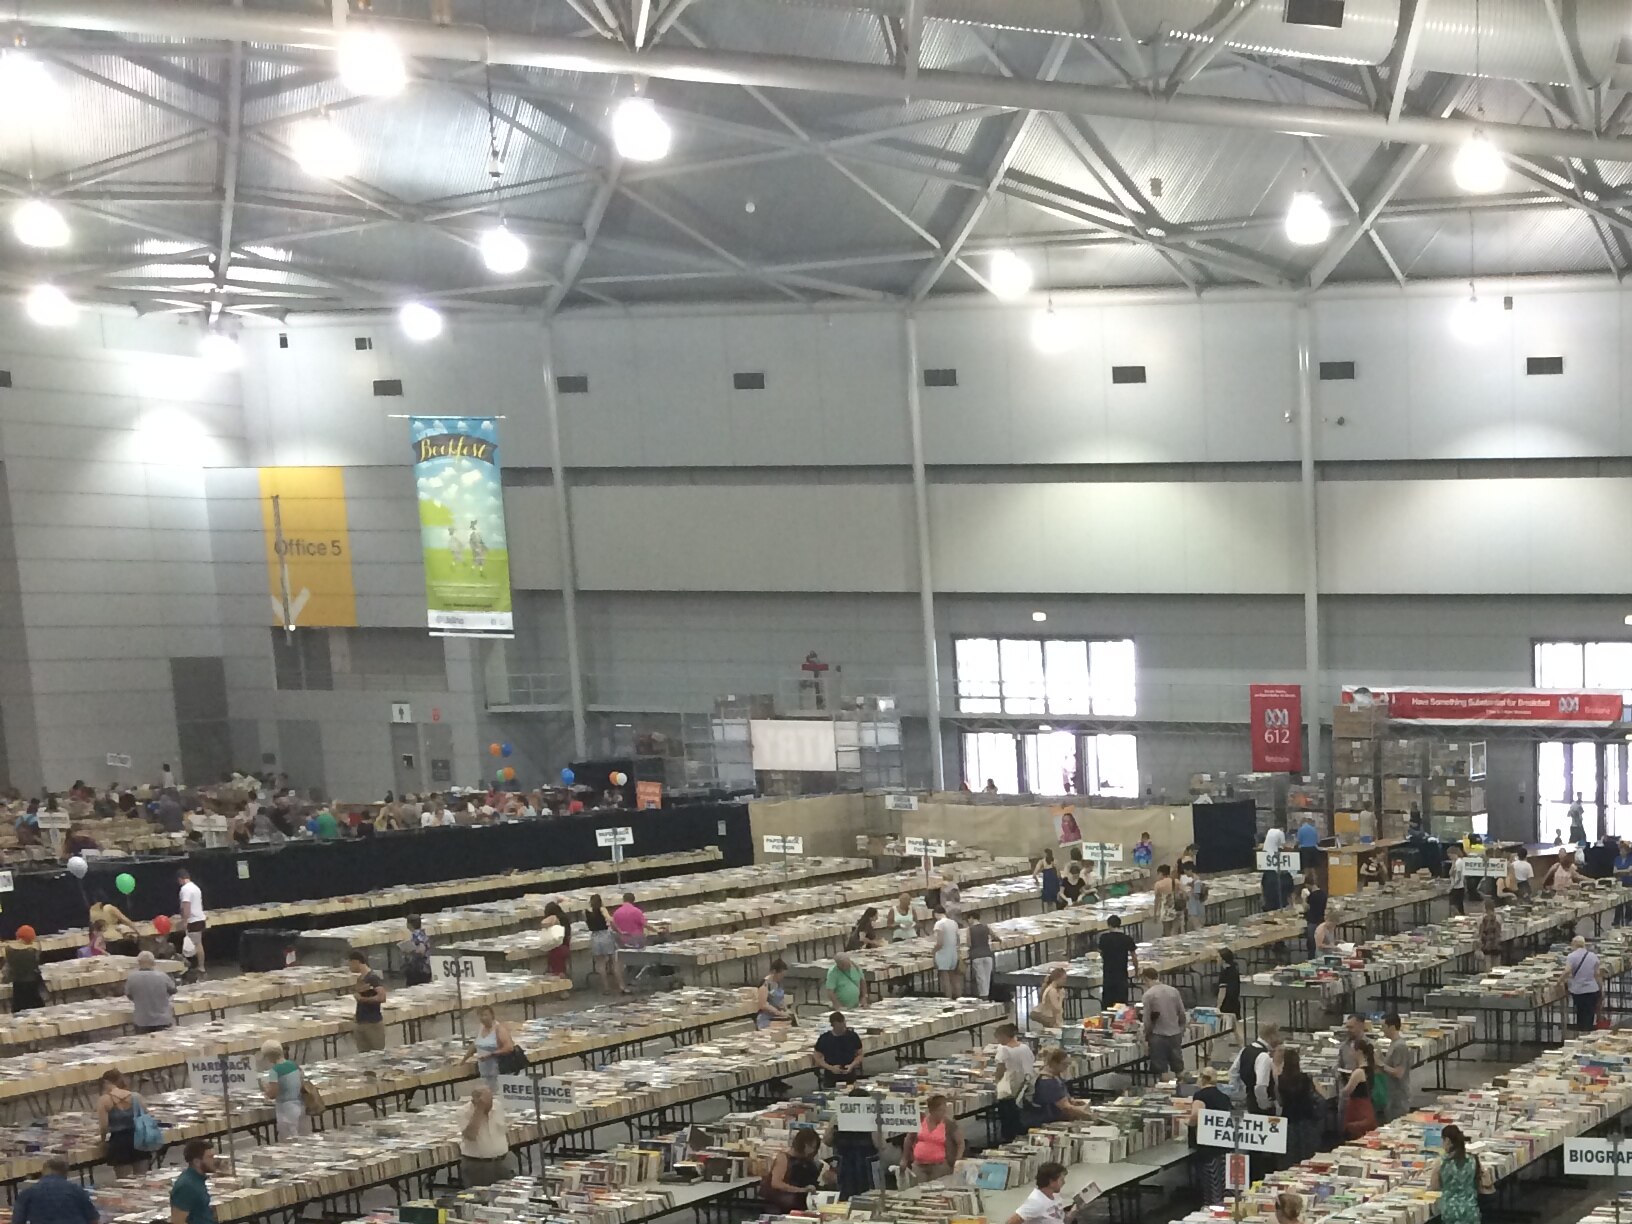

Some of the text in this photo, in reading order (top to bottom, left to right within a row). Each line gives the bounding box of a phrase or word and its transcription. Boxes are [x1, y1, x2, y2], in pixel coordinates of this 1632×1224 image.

[274, 539, 342, 556] Office 5
[1264, 729, 1290, 744] 612
[1464, 861, 1505, 869] REFEENCE
[443, 960, 475, 978] SCI-FI
[192, 1060, 252, 1072] HARDACK
[202, 1073, 246, 1084] FICTION
[503, 1084, 571, 1097] REFEENCE
[866, 1103, 895, 1115] HOBIES
[876, 1117, 917, 1126] ARDENING
[1204, 1115, 1279, 1133] HEALTH &
[1214, 1130, 1268, 1145] FAMILY
